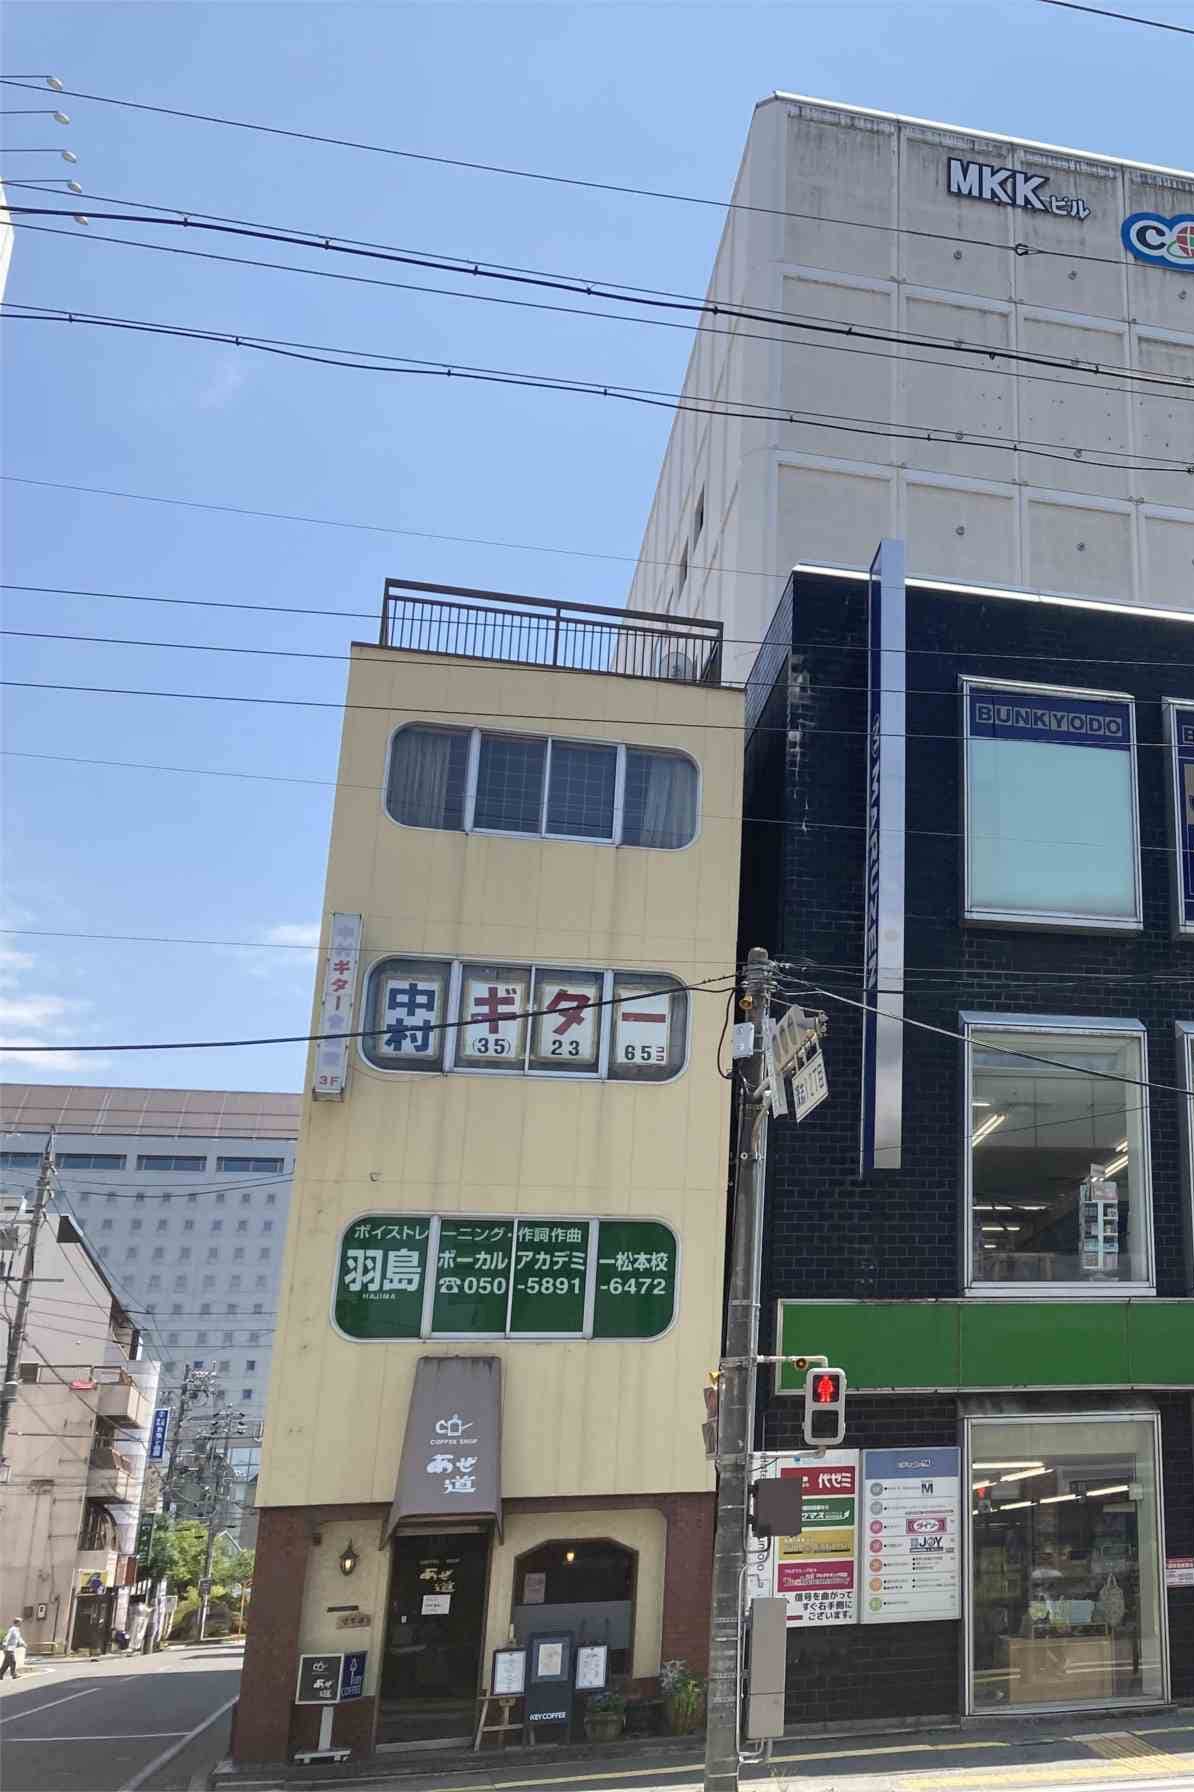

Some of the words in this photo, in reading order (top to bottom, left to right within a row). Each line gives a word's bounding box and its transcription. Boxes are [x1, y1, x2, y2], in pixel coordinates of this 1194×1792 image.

[975, 703, 1123, 737] BUNKYODO
[384, 982, 436, 1053] 中村
[319, 1075, 340, 1086] 3F
[344, 1248, 422, 1292] 羽島
[438, 1249, 669, 1273] ボーカルアカデミー松本校
[443, 1474, 477, 1494] 道
[818, 1472, 852, 1489] 代ゼミ
